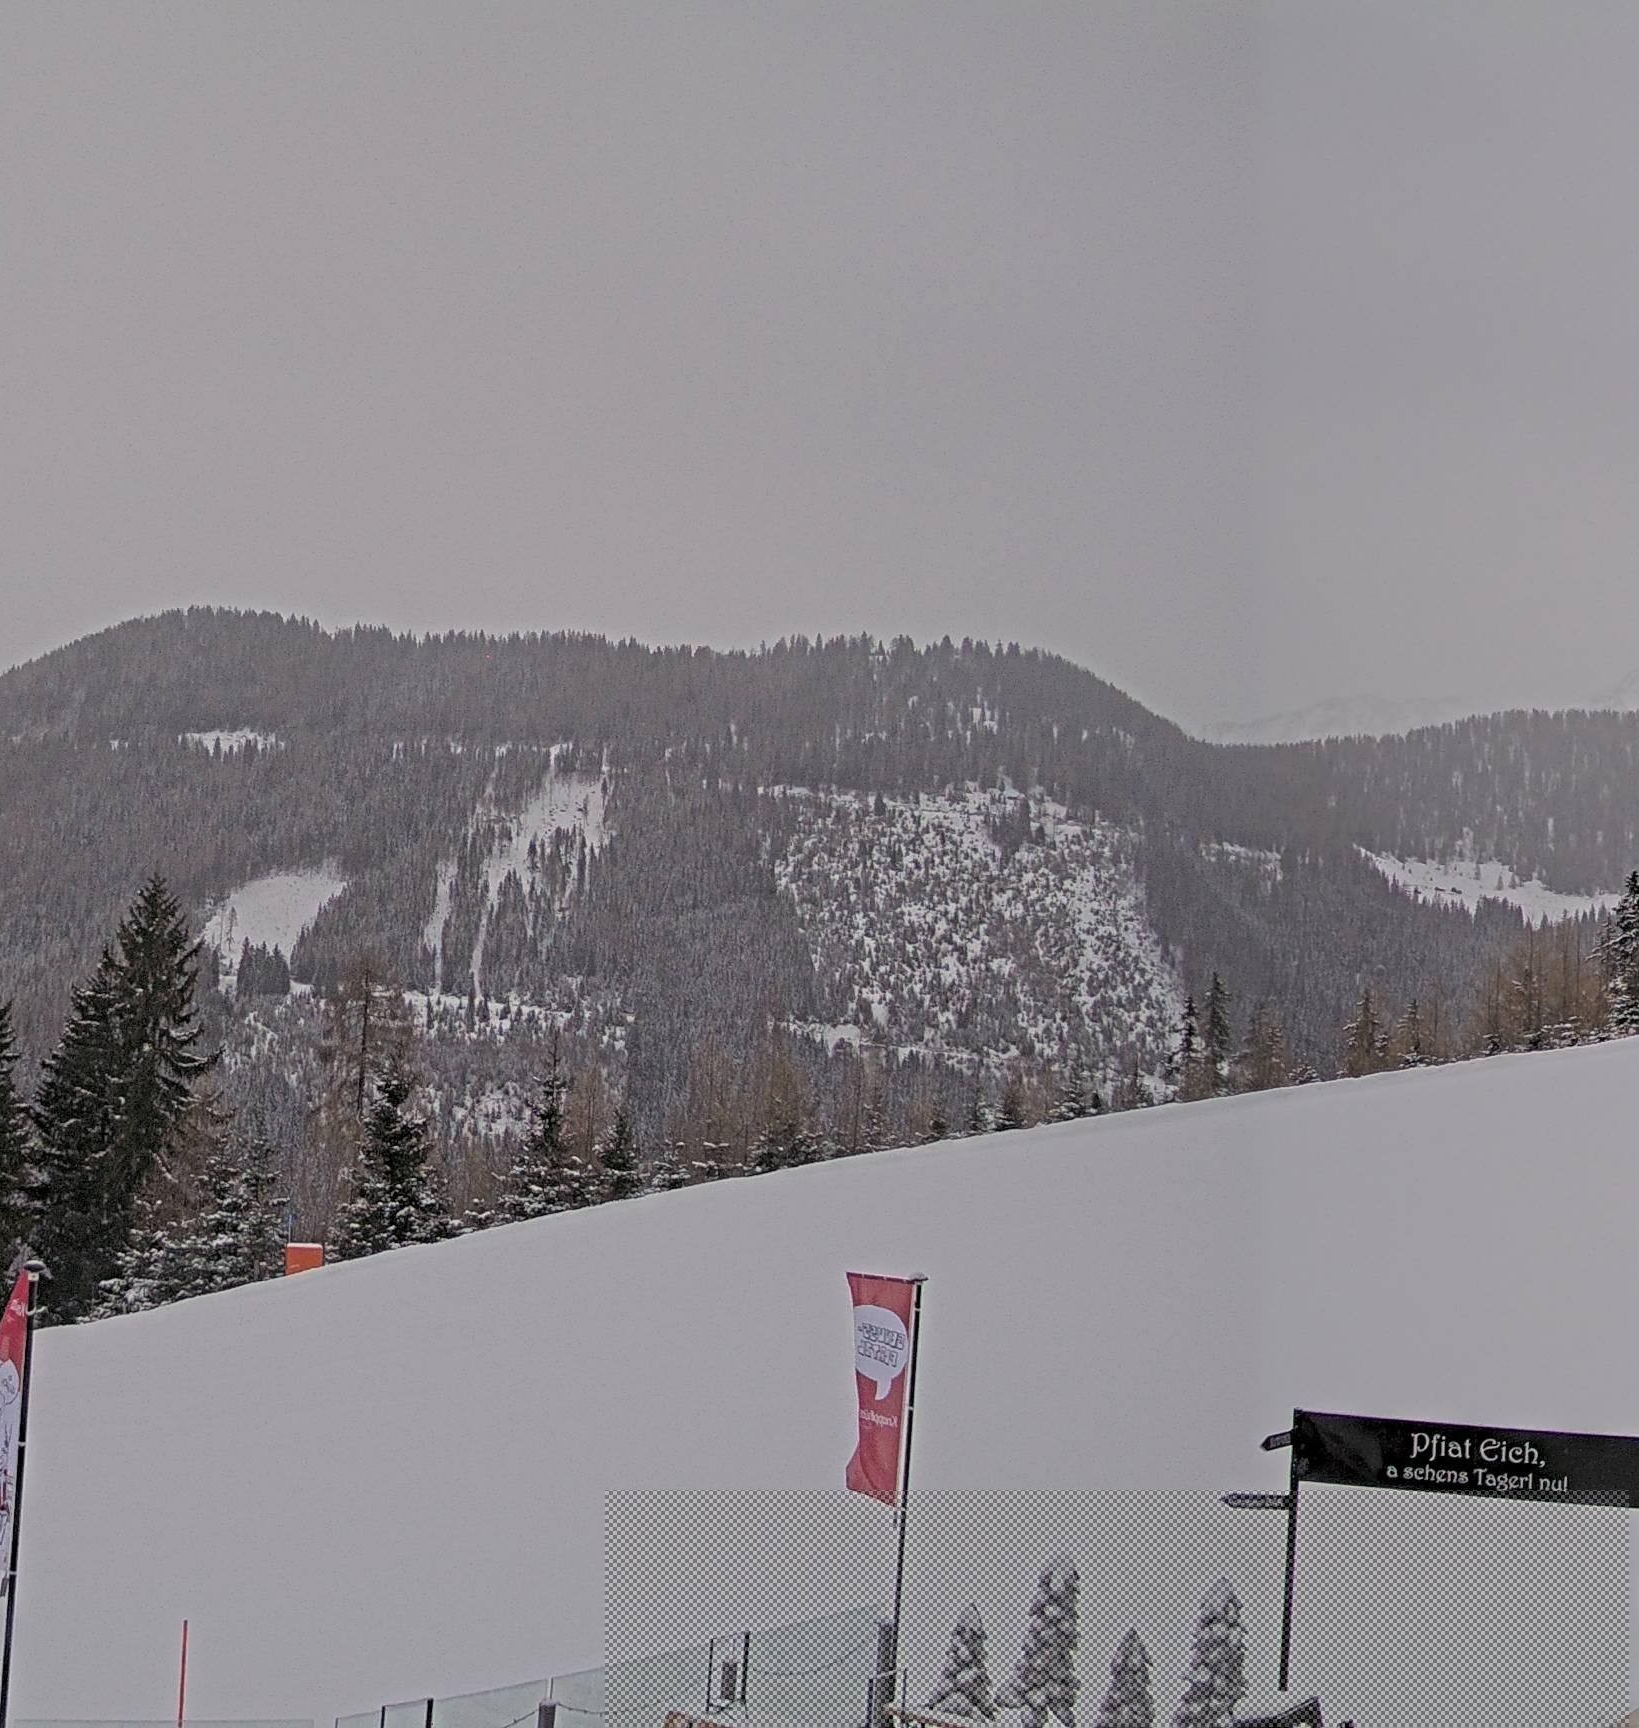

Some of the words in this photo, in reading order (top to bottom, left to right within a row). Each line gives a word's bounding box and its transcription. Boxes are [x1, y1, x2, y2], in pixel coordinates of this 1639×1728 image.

[1410, 1432, 1472, 1462] Pfiat
[1480, 1438, 1546, 1468] Eich,
[1386, 1465, 1398, 1478] a
[1403, 1464, 1469, 1484] schens
[1473, 1468, 1533, 1492] Tagerl
